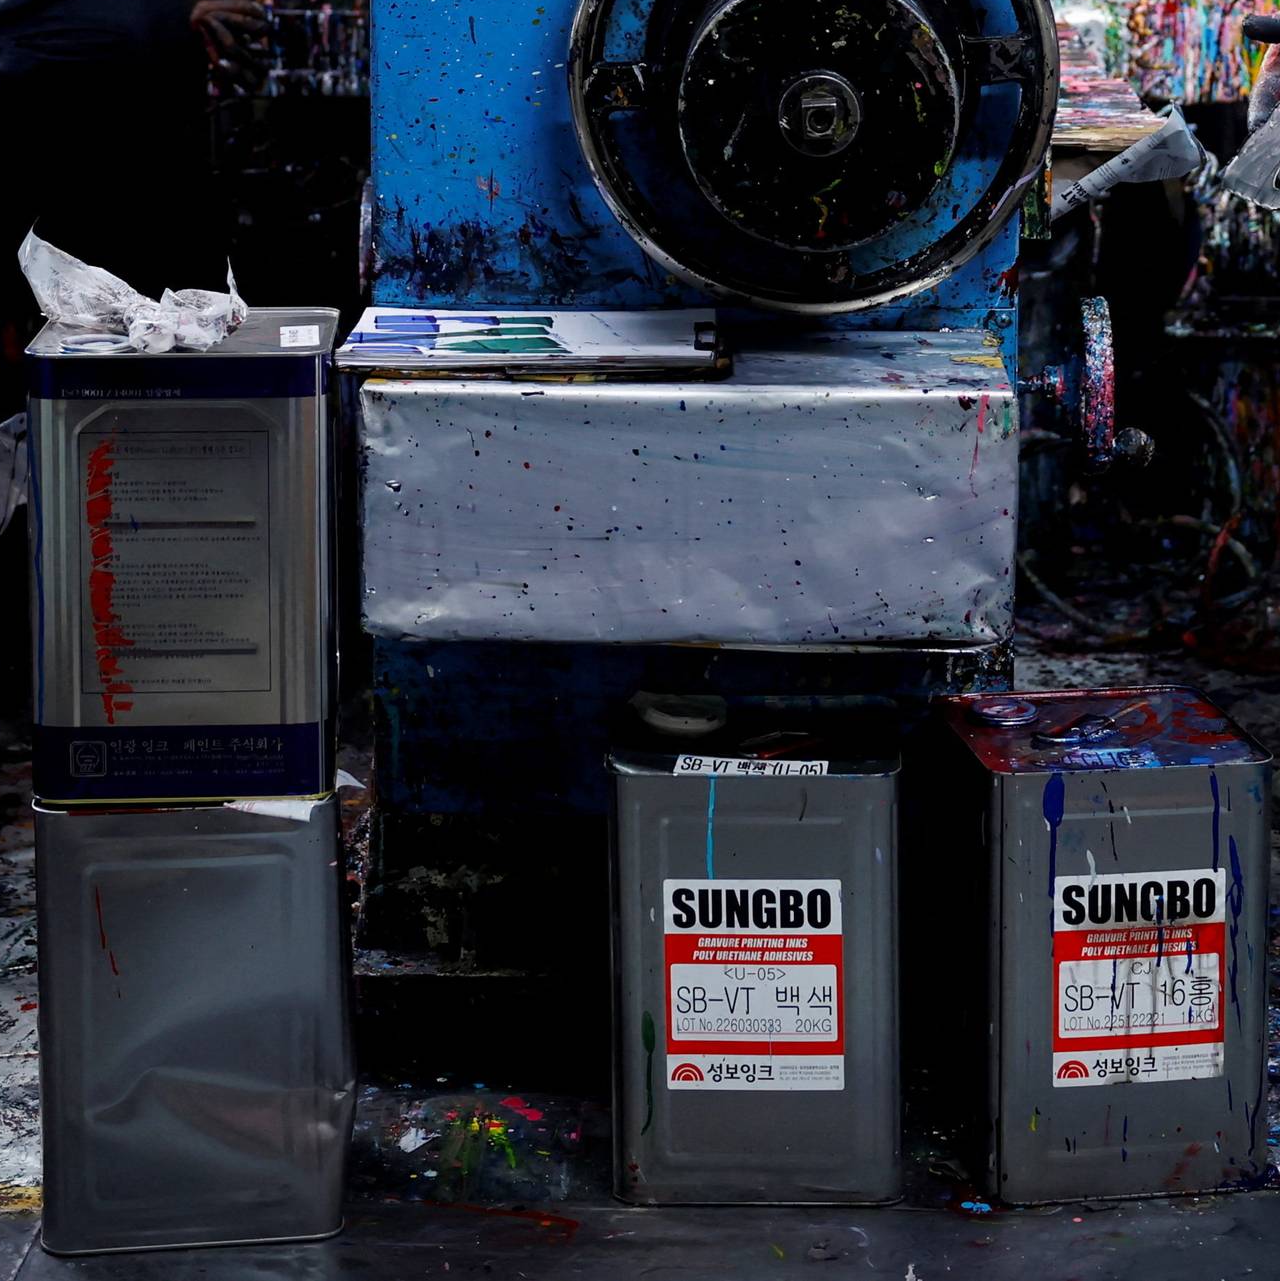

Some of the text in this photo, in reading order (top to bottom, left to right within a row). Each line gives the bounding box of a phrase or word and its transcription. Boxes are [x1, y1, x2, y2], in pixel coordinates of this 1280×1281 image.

[680, 757, 733, 774] SB-VT
[672, 888, 831, 929] SUNGBO
[1062, 878, 1216, 926] SUNGBO
[698, 937, 808, 948] GRAVURE PRINTING INKS
[1087, 932, 1127, 943] GRAVURE
[1171, 928, 1193, 939] INKS
[693, 950, 814, 961] POLY URETHANE ADHESIVES
[1081, 946, 1103, 957] POLY
[1104, 943, 1149, 956] URETHANE
[724, 968, 786, 981] <U-05>
[676, 986, 755, 1015] SB-VT
[1064, 982, 1140, 1012] SB-VT
[677, 1017, 696, 1032] LOT
[795, 1018, 832, 1033] 20KG
[1064, 1016, 1082, 1030] LOT
[707, 1063, 775, 1083] 성보잉크
[1092, 1056, 1158, 1078] 성보잉크
